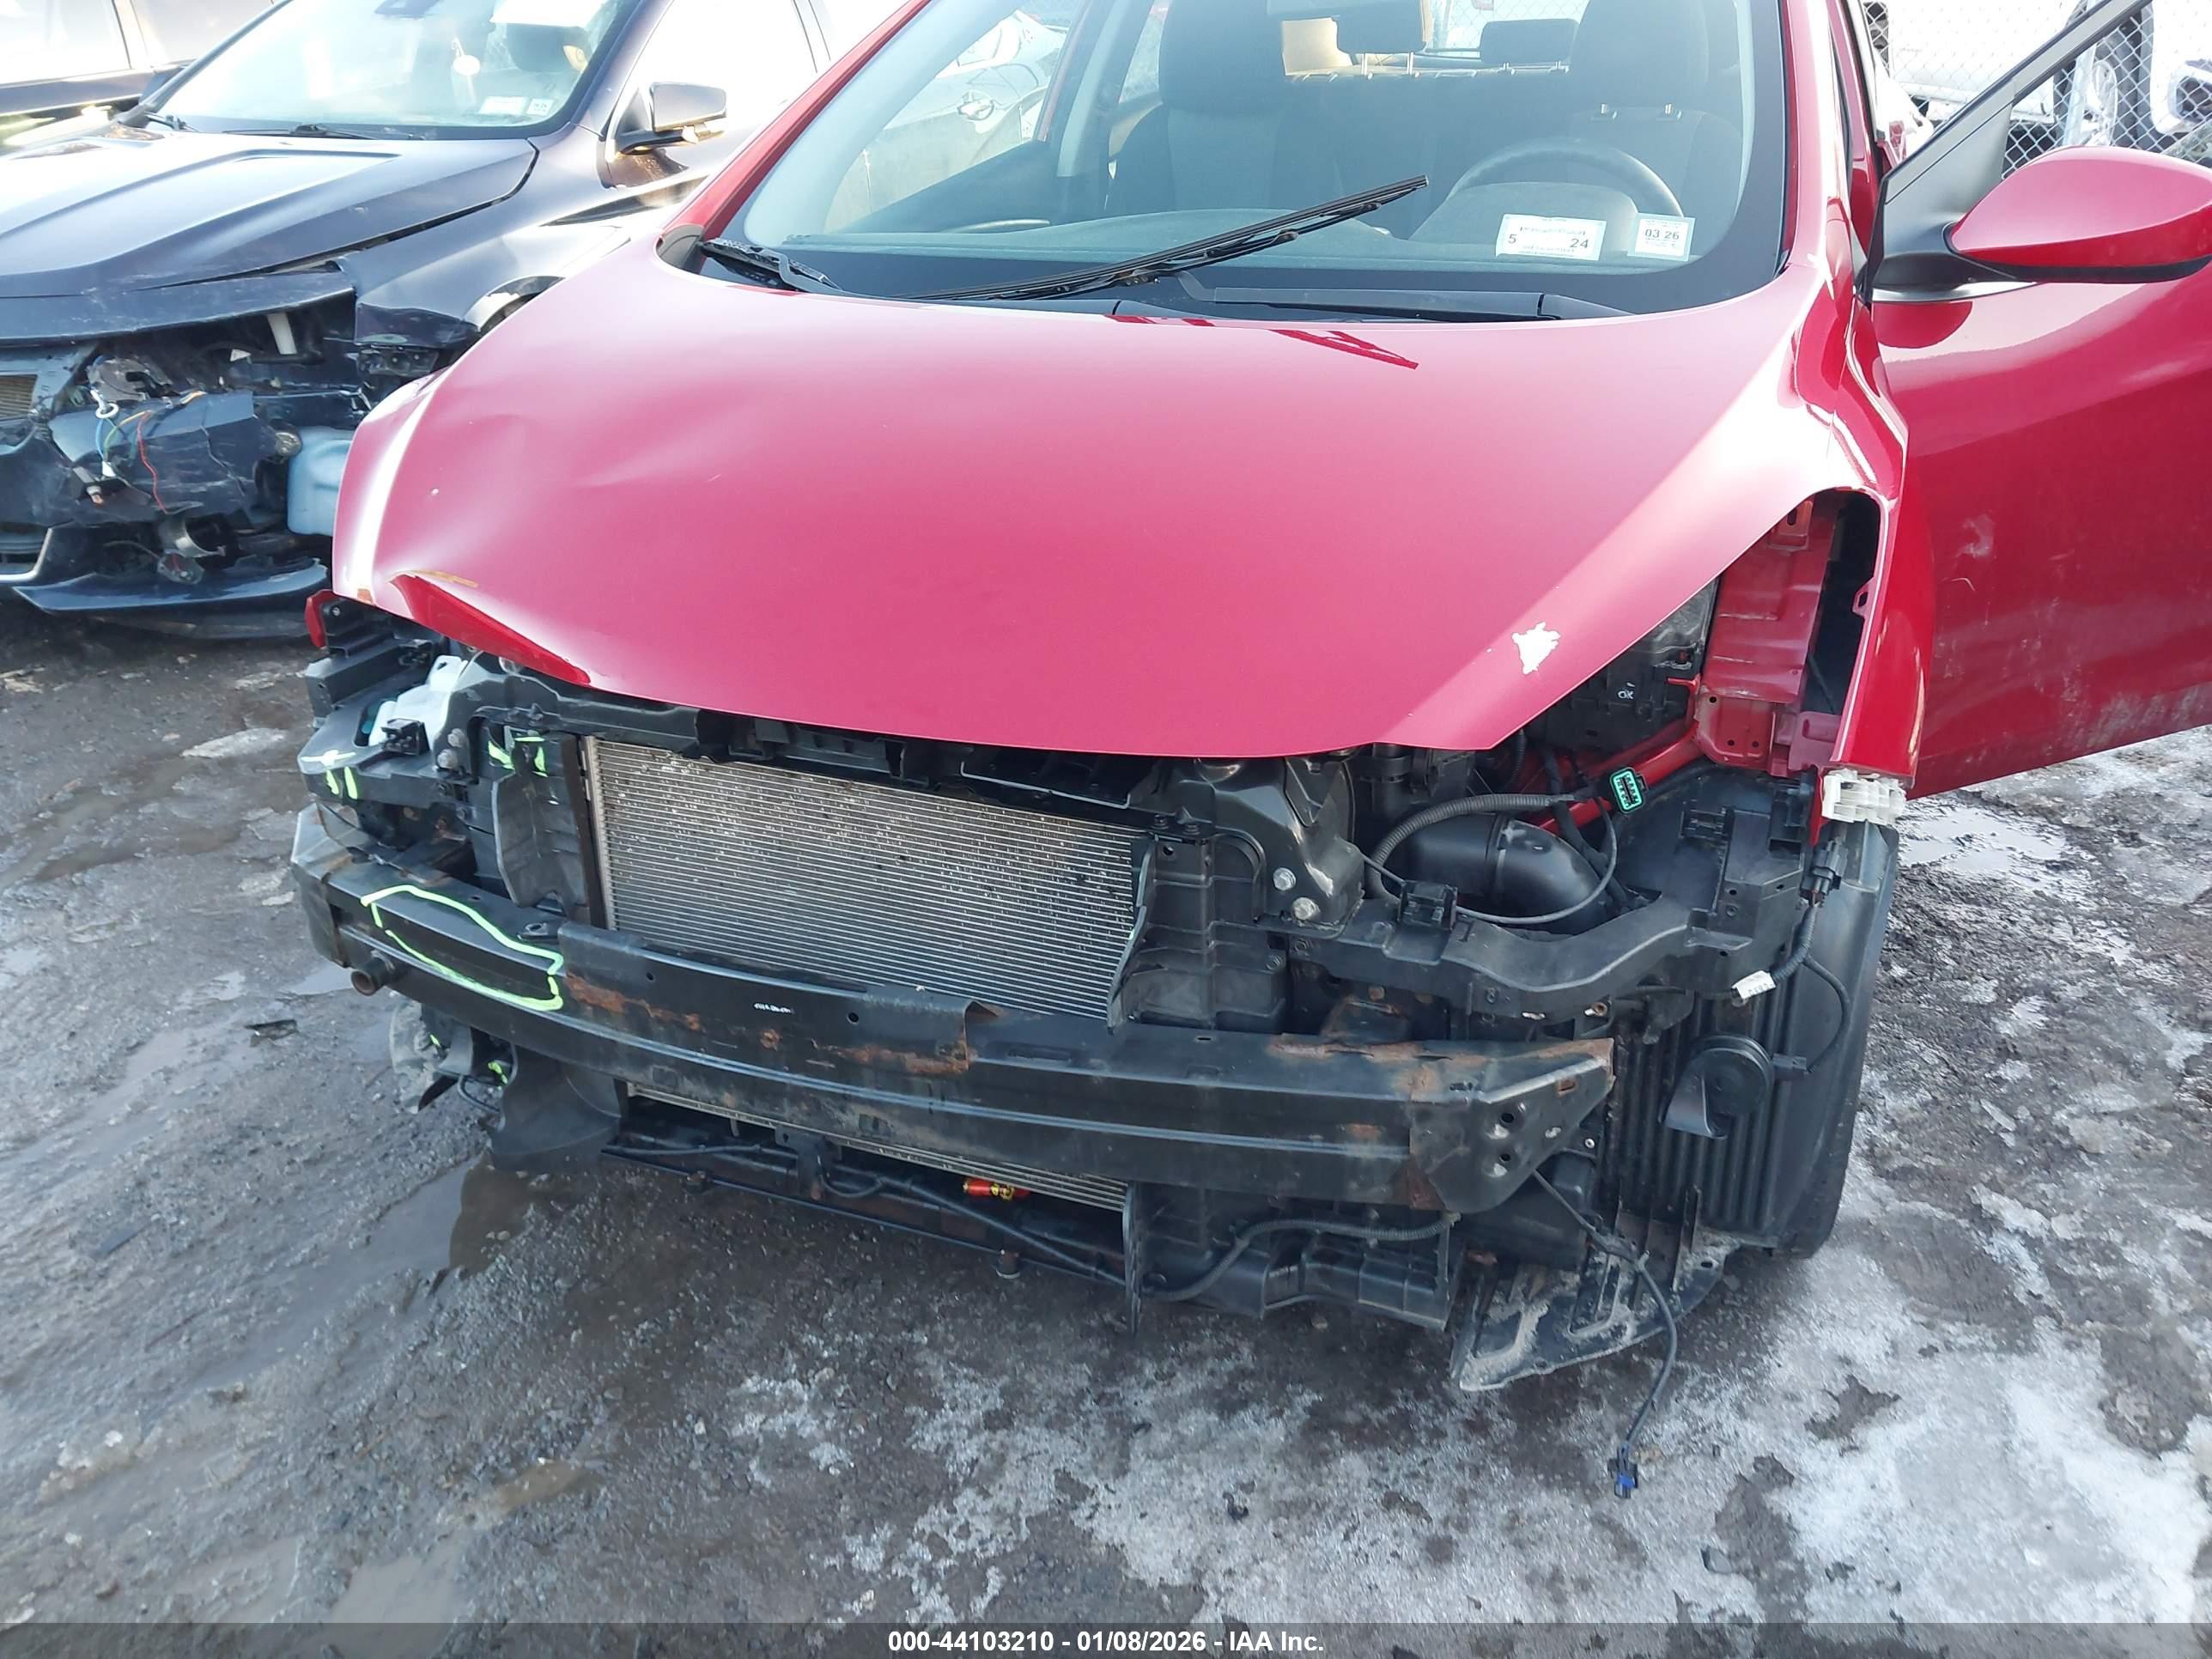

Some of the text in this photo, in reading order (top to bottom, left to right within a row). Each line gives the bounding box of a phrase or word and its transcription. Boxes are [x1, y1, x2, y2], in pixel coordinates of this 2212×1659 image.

[1644, 228, 1680, 240] 03 26
[1508, 234, 1517, 245] 5
[1570, 238, 1589, 249] 24
